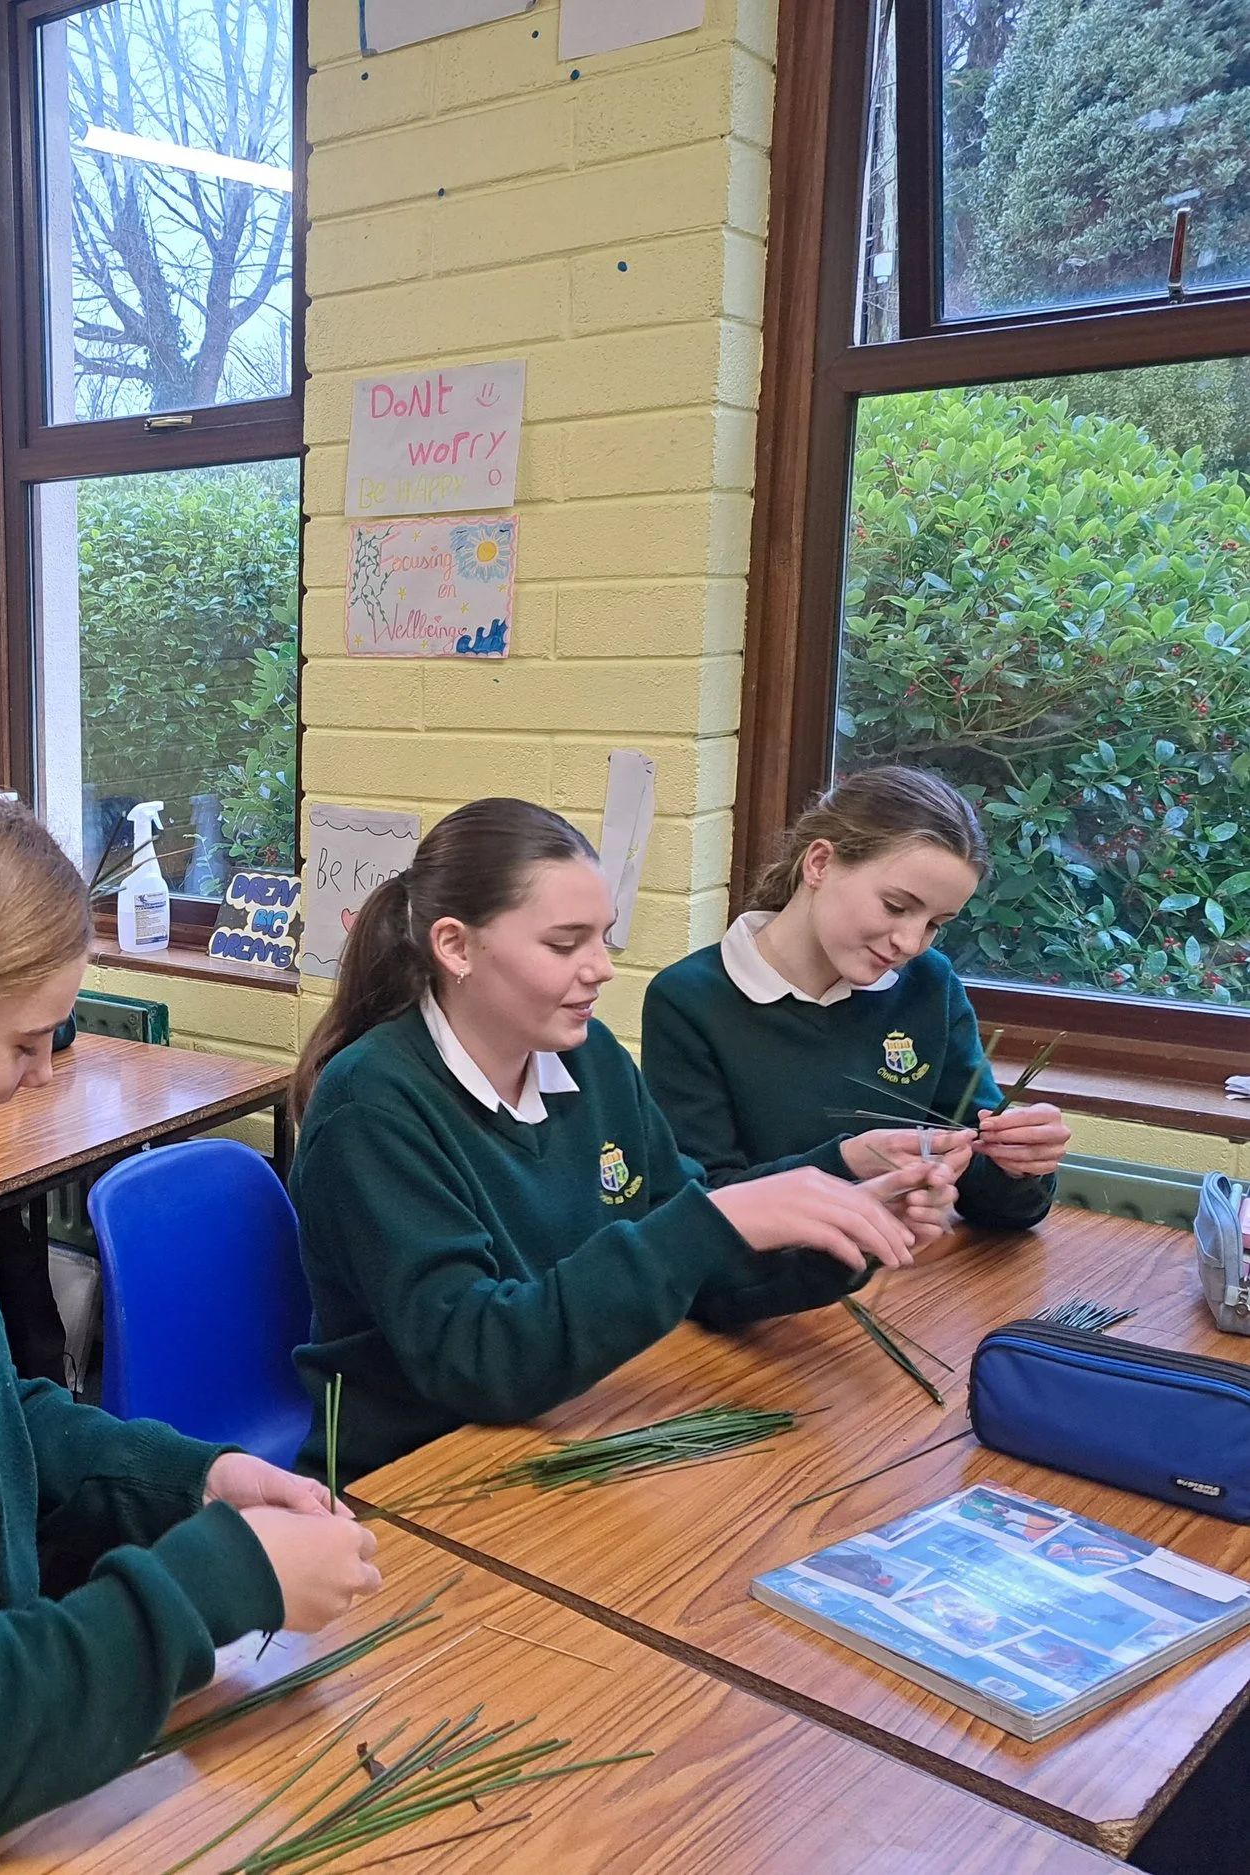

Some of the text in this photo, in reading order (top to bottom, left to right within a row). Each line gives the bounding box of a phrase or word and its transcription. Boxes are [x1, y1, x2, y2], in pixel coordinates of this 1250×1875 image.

[396, 471, 467, 507] HAPPY
[379, 530, 454, 579] Focusing
[438, 582, 457, 599] on
[316, 847, 343, 893] Be
[252, 909, 289, 939] BIG
[211, 931, 292, 968] DREAMS
